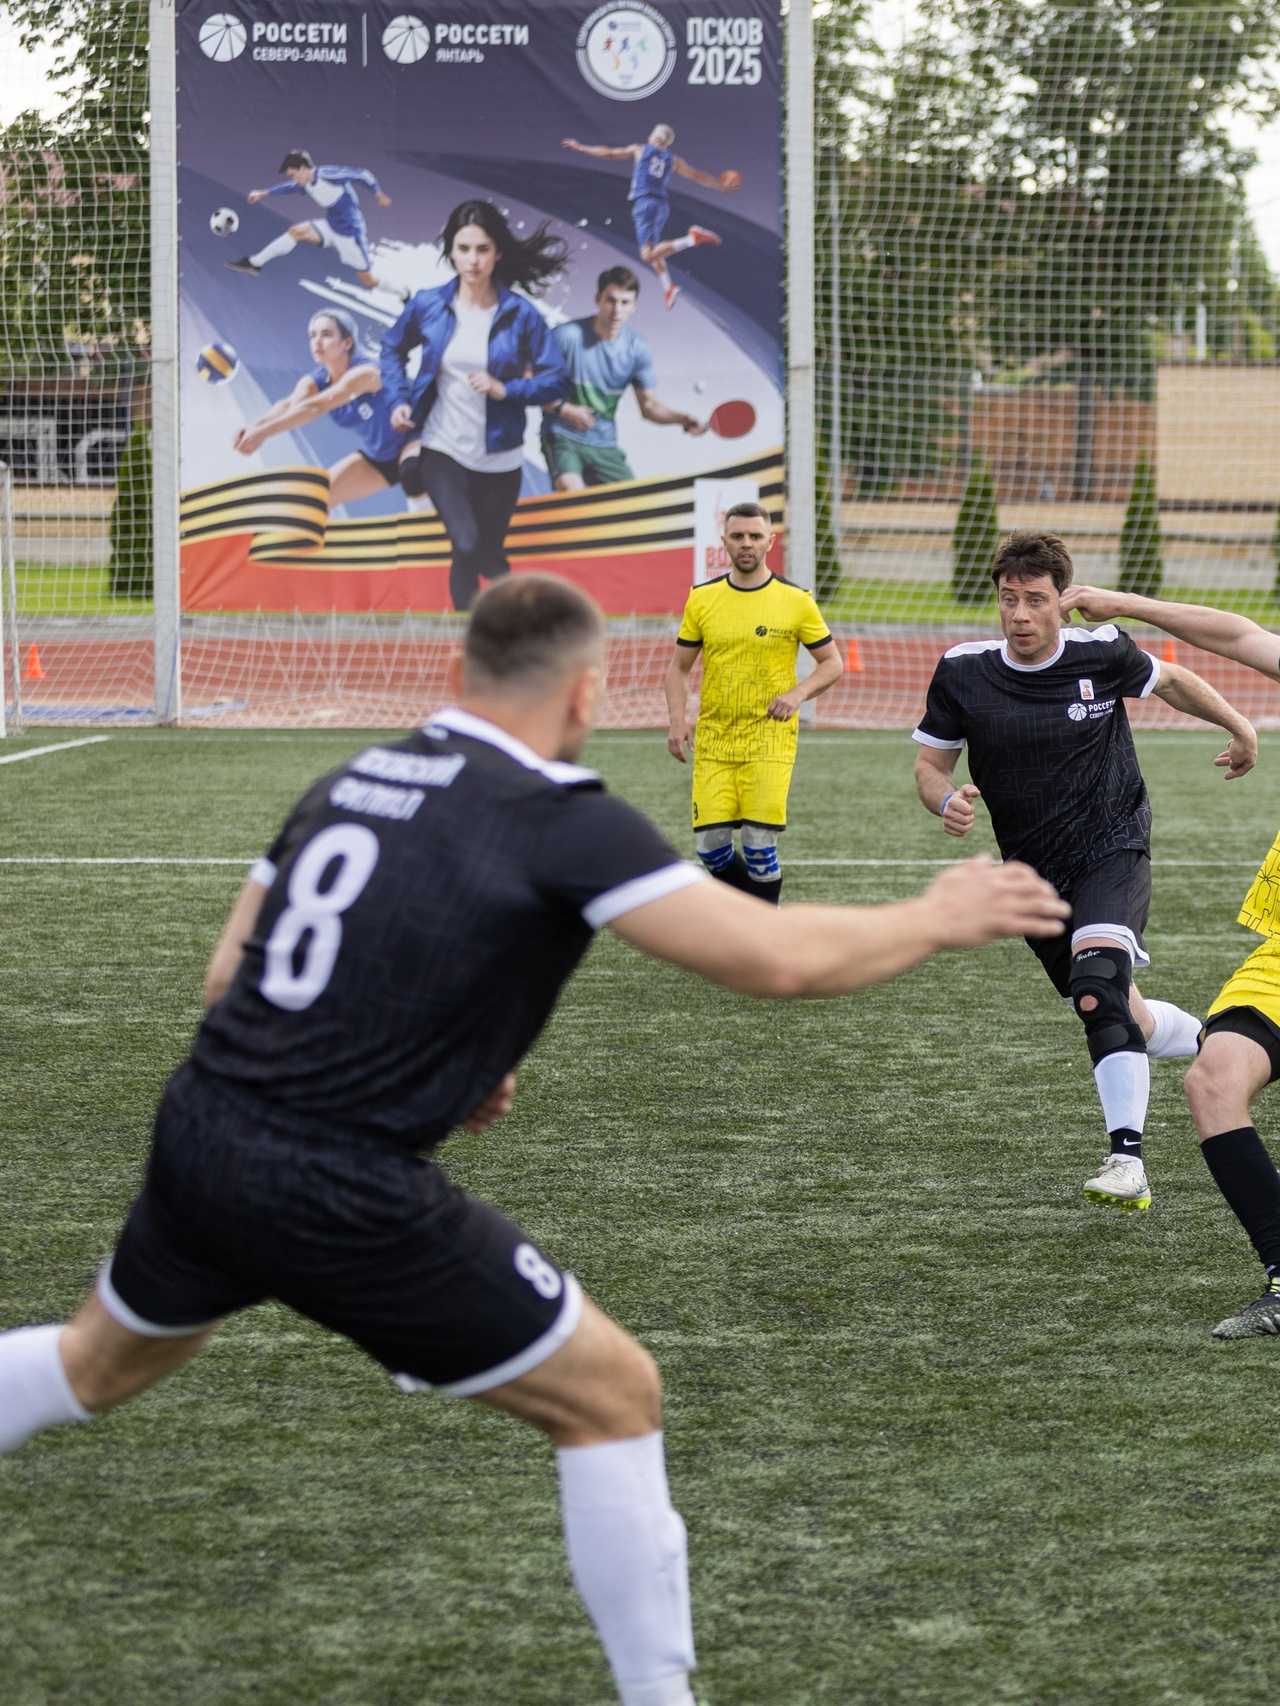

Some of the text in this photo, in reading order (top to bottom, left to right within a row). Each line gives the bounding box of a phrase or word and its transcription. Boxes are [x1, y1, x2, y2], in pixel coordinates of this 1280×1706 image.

[252, 22, 348, 45] РОССЕТИ
[434, 24, 530, 46] РОССЕТИ
[686, 17, 764, 46] ПСКОВ
[252, 47, 348, 65] СЕВЕРО-ЗАПАД
[435, 48, 485, 64] ЯНТАРЬ
[687, 46, 763, 86] 2025
[259, 822, 380, 1012] 8
[513, 1242, 562, 1300] 8
